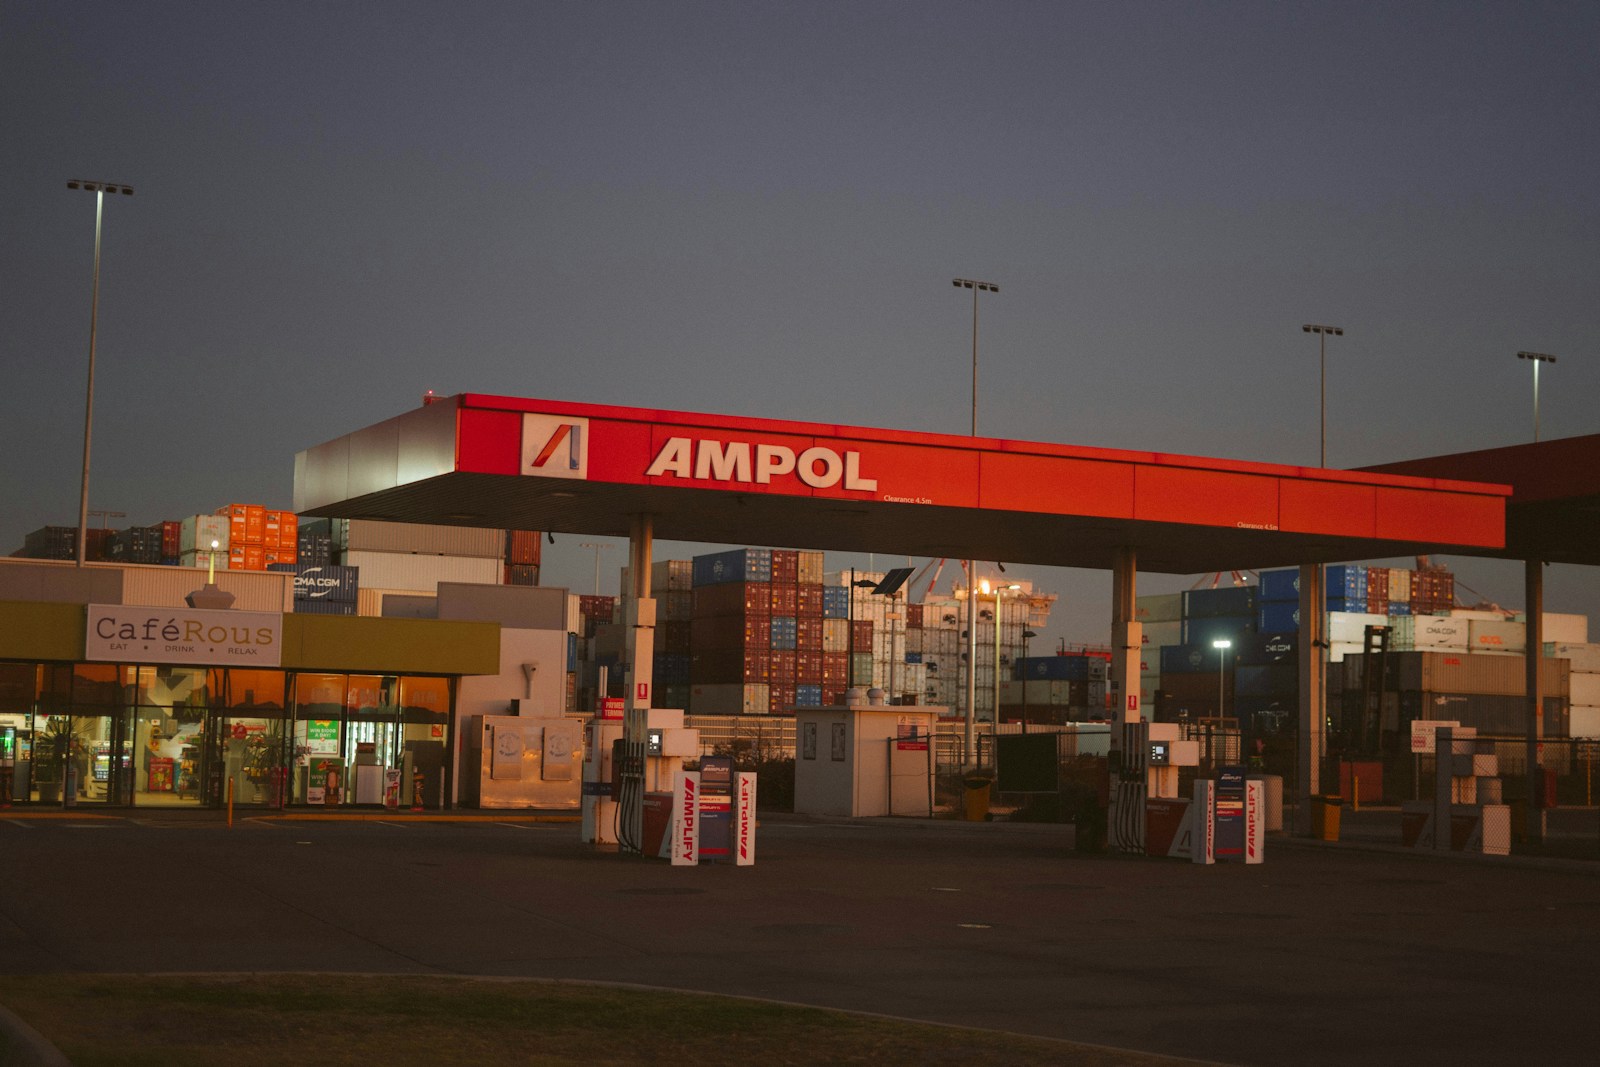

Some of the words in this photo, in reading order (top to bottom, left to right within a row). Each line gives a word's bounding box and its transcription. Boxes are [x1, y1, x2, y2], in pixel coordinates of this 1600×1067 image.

[644, 436, 878, 492] AMPOL
[883, 494, 914, 503] Clearance
[915, 497, 932, 505] 4.5m
[317, 578, 340, 587] CGM
[110, 643, 128, 651] EAT
[165, 645, 195, 653] DRINK
[228, 647, 258, 655] RELAX
[682, 790, 694, 861] AMPLIFY
[740, 777, 749, 847] AMPLIFY
